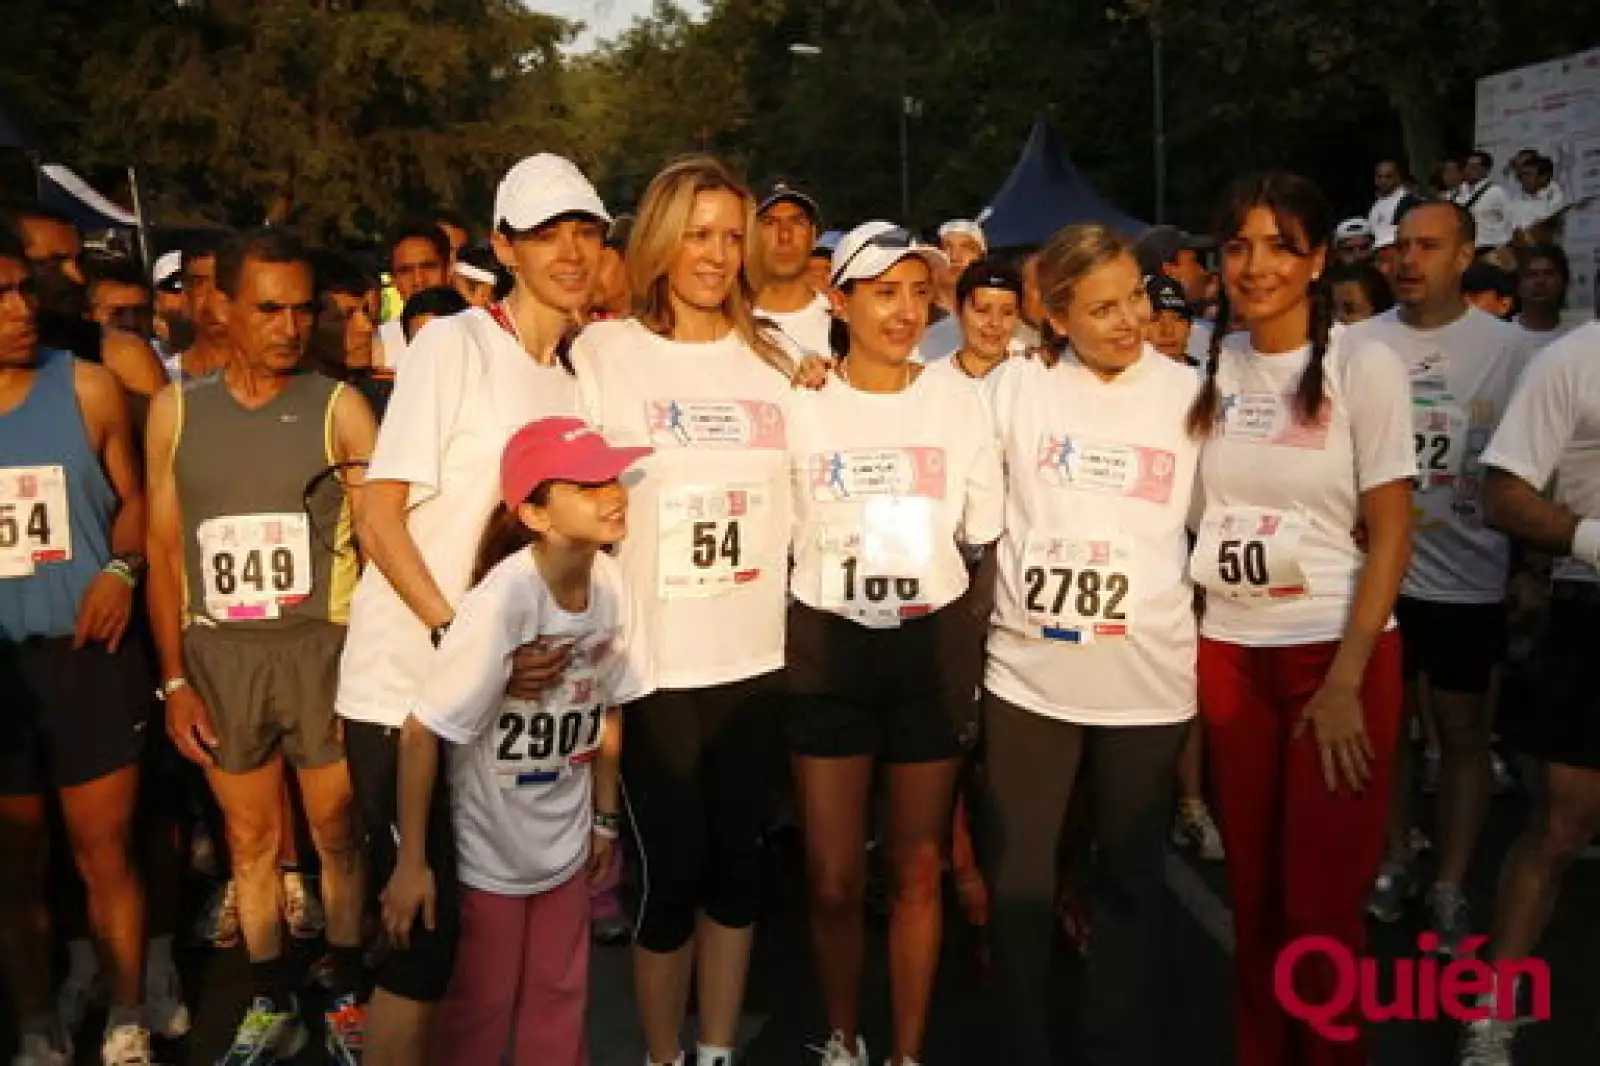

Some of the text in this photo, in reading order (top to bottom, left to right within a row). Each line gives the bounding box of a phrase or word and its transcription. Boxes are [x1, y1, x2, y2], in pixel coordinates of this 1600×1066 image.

[692, 521, 741, 567] 54
[1218, 540, 1269, 586] 50
[213, 548, 295, 594] 849
[1025, 567, 1129, 620] 2782
[497, 703, 601, 760] 2901
